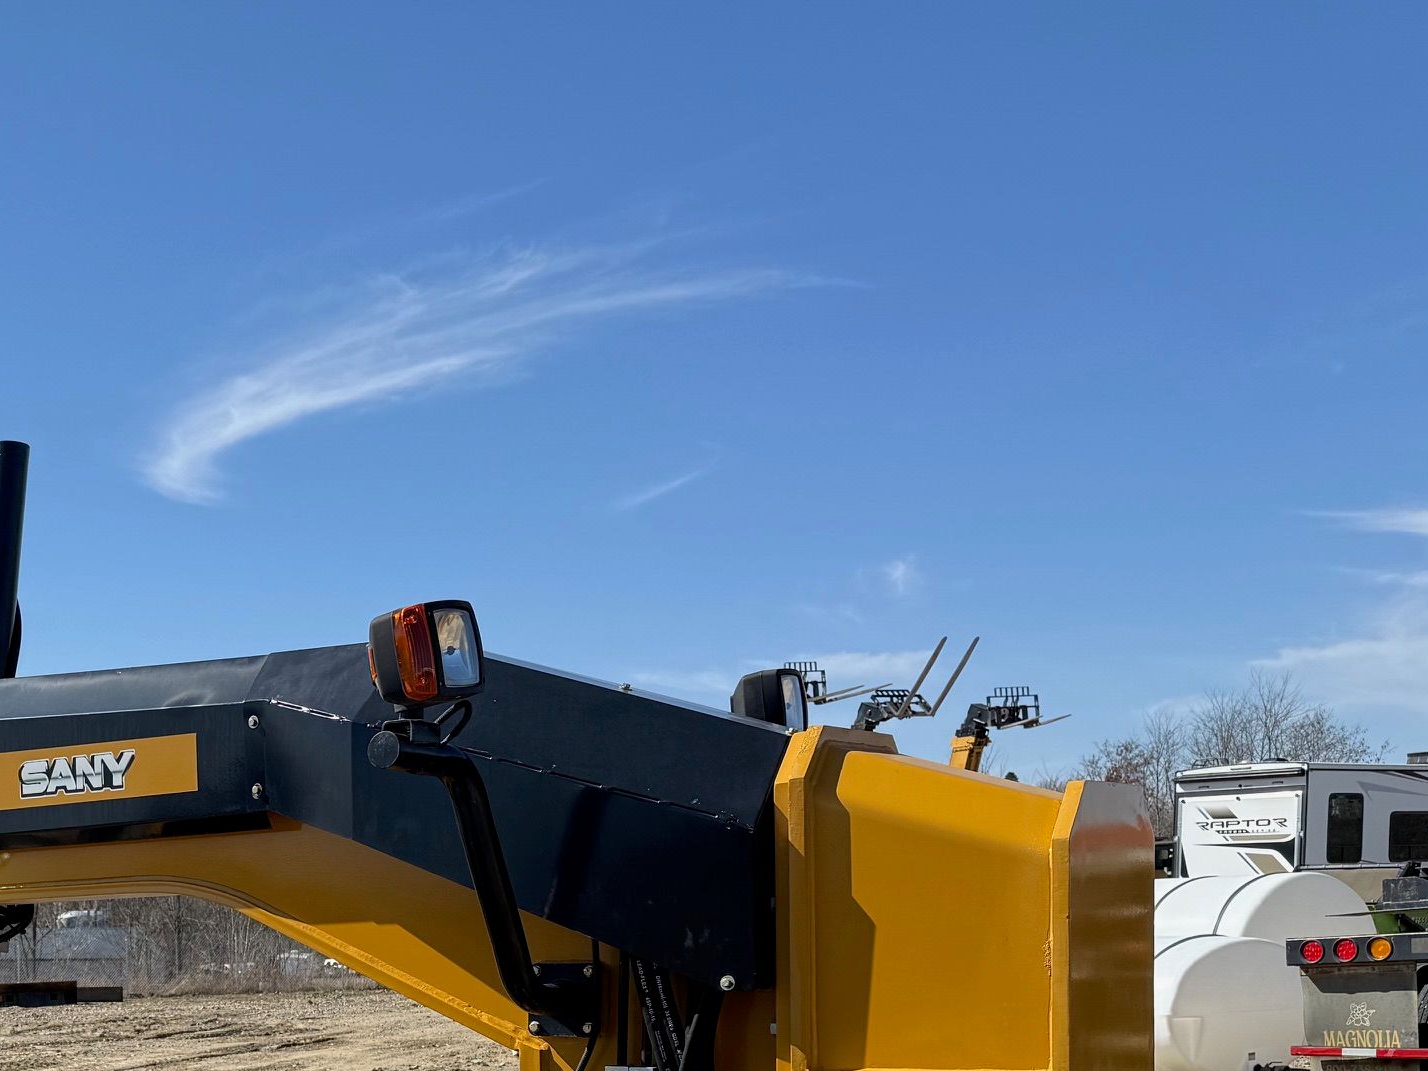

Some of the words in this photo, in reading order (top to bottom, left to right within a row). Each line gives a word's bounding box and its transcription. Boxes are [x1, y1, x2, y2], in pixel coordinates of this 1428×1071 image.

[20, 750, 135, 798] SANY
[1196, 818, 1288, 831] RAPTOR
[1323, 1029, 1401, 1048] MAGNOLIA
